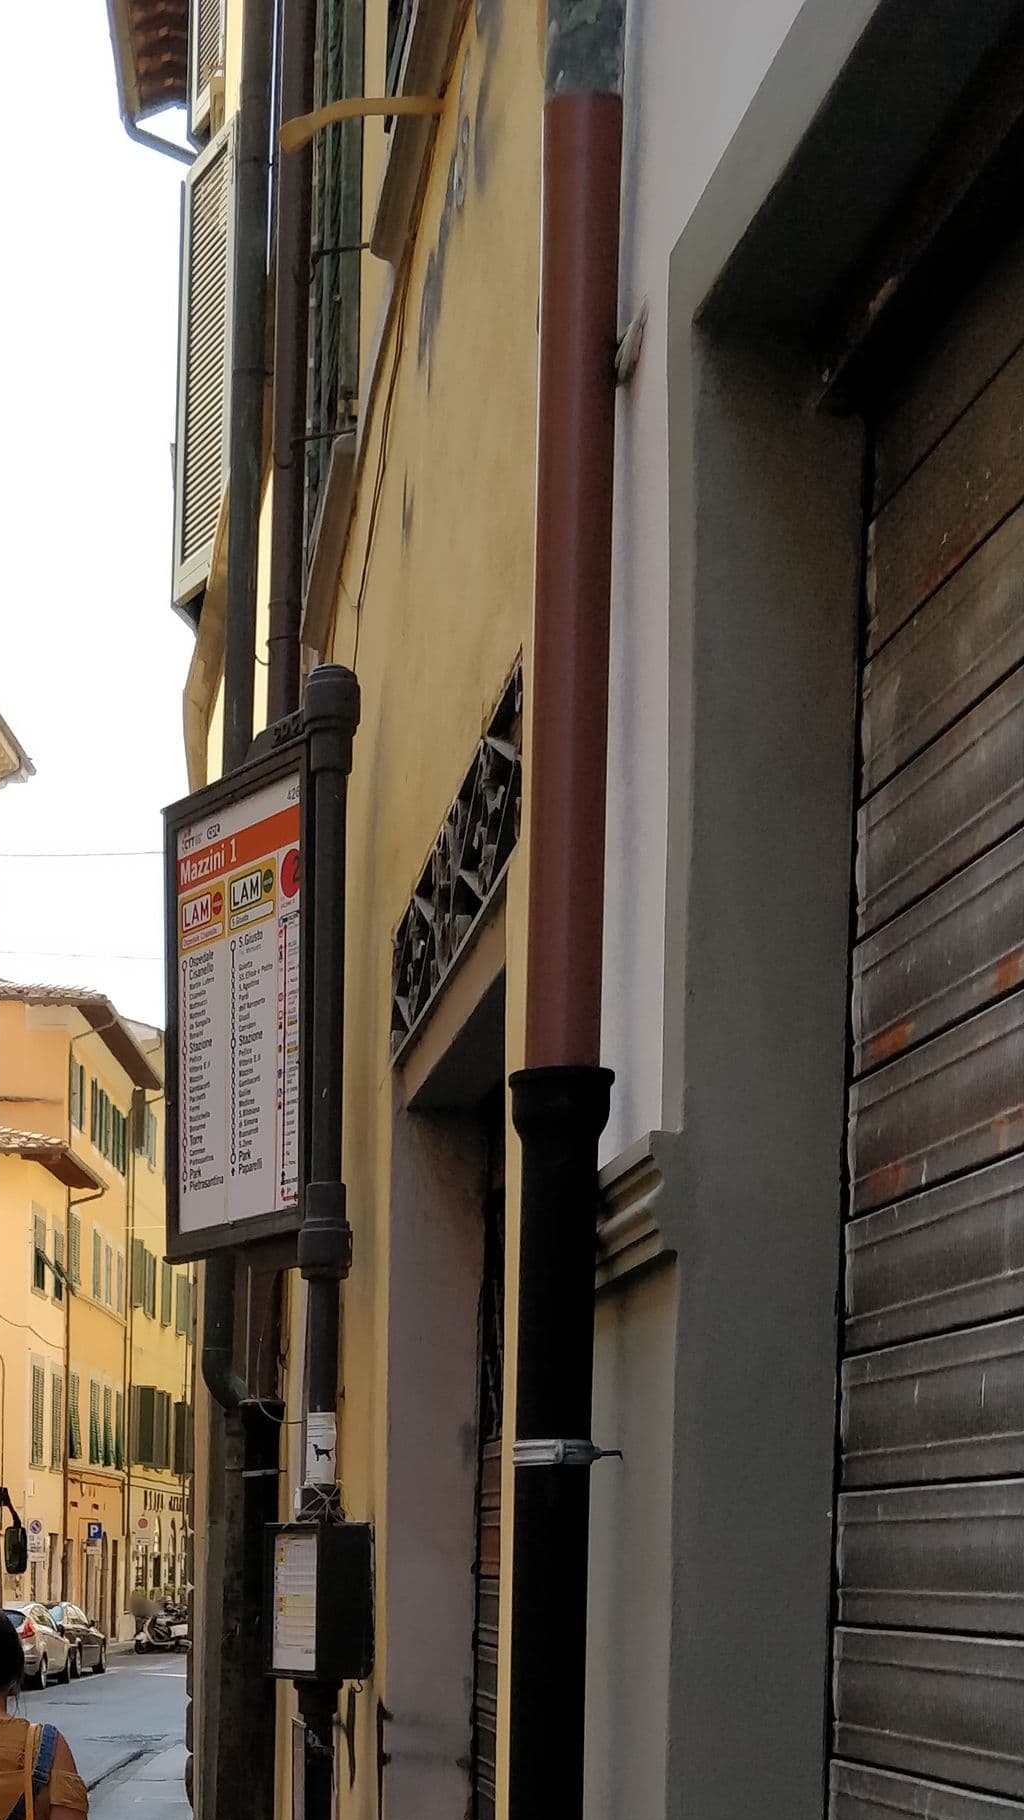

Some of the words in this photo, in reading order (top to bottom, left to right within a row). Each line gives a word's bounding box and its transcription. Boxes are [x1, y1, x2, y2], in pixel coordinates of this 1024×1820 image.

[180, 843, 225, 886] Mazzini
[230, 838, 238, 863] 1
[232, 874, 260, 906] LAM
[183, 901, 210, 928] LAM
[189, 950, 214, 968] Ospedale
[189, 962, 214, 980] Cisanello
[189, 1039, 213, 1053] Stazione
[238, 1030, 263, 1046] Stazione
[189, 1134, 203, 1147] Torre
[238, 1150, 252, 1163] Park
[189, 1168, 202, 1180] Park
